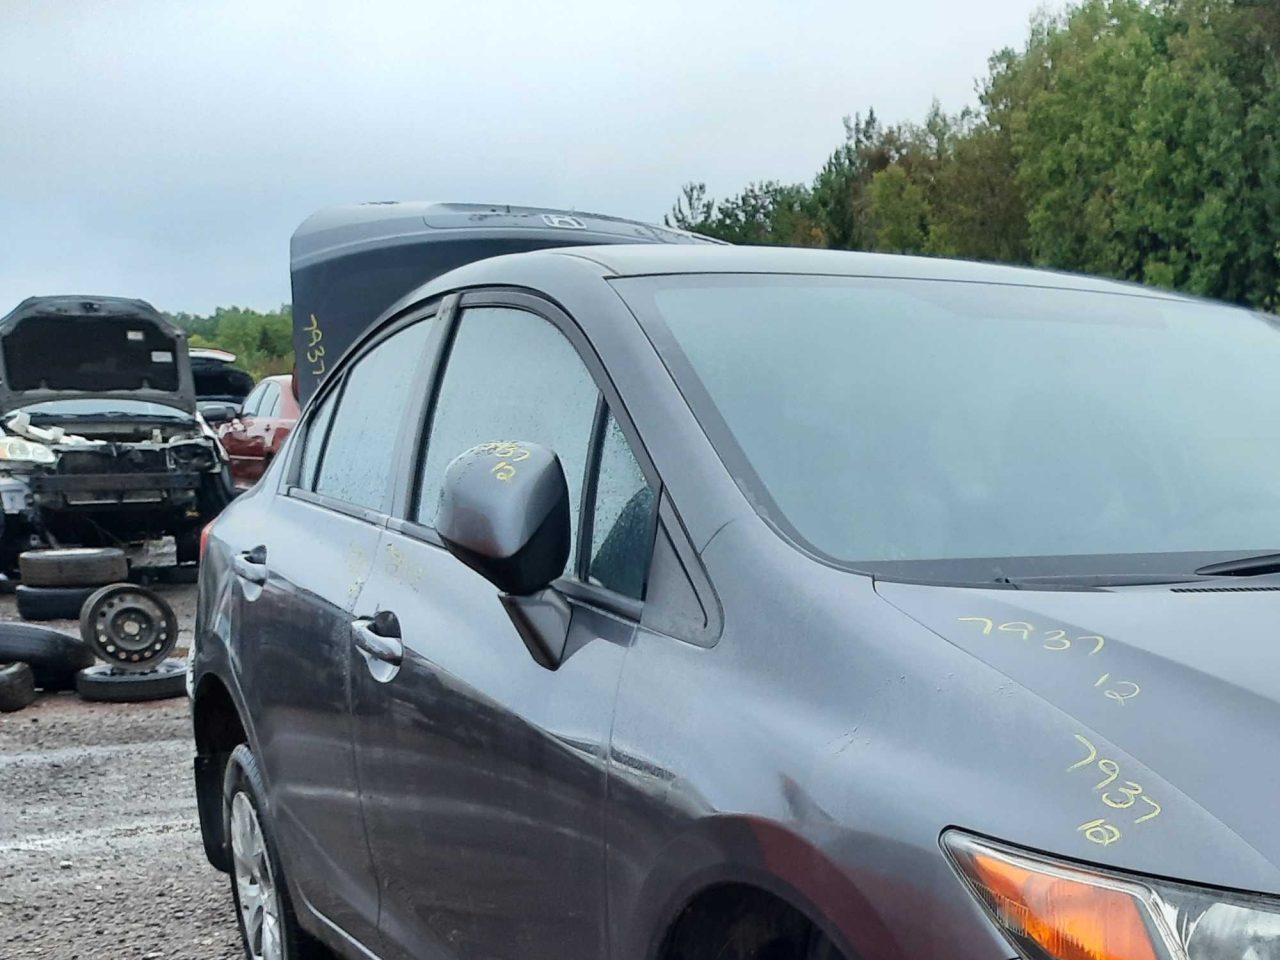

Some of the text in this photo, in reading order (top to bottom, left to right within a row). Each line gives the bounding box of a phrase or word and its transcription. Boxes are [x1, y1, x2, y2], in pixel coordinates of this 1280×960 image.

[957, 616, 1105, 656] 7937
[1094, 672, 1141, 706] 12
[1065, 733, 1162, 824] 7937
